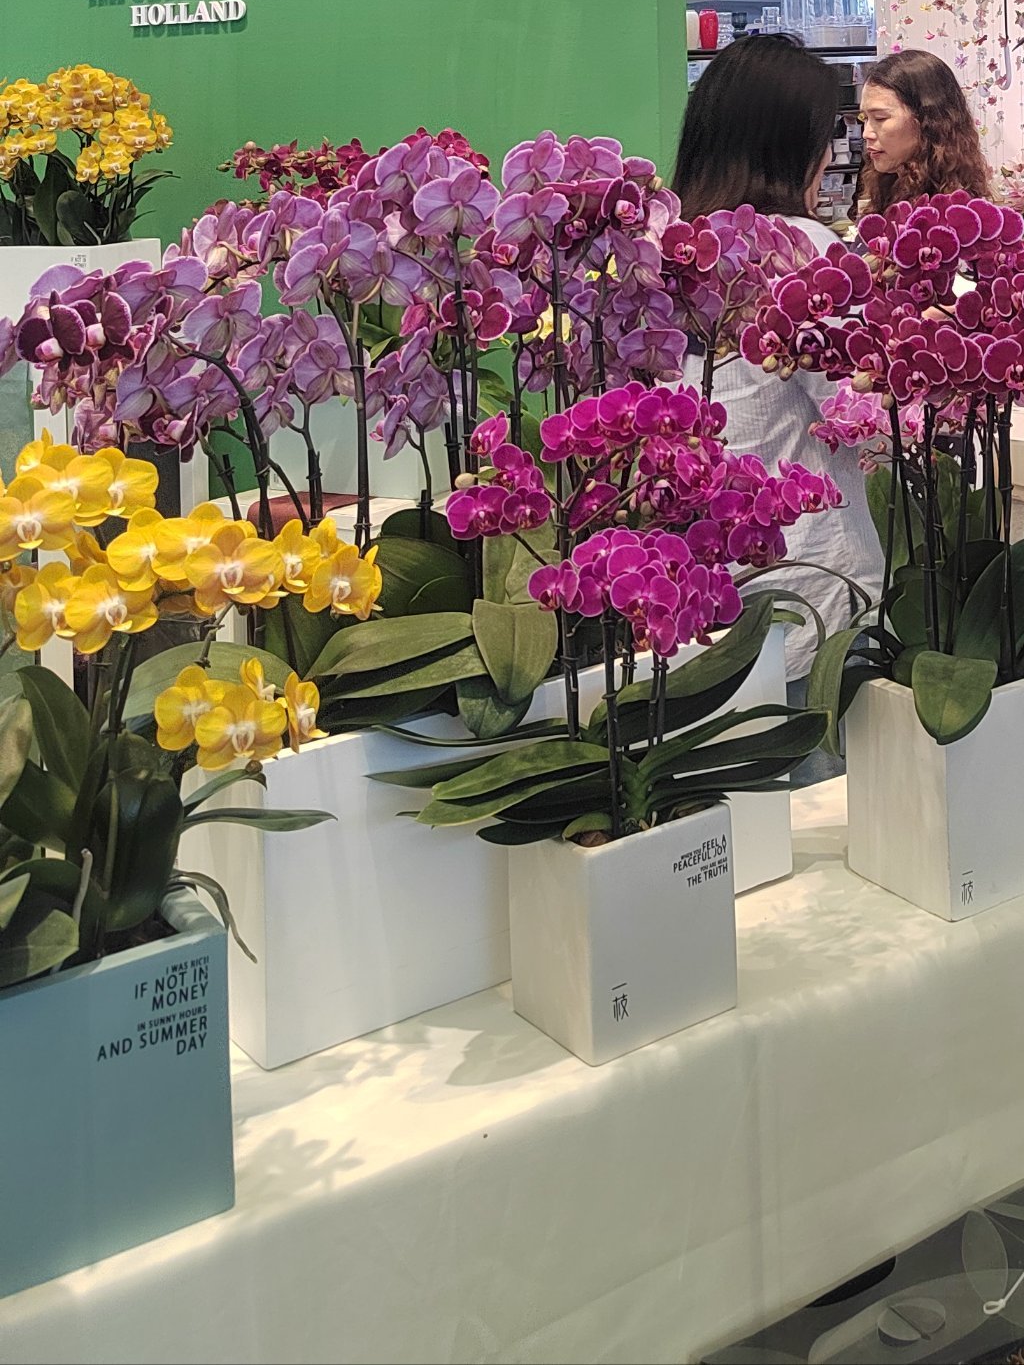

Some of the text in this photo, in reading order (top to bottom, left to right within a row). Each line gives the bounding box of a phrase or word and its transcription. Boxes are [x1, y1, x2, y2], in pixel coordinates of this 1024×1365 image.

[673, 842, 727, 873] PEACEFUL JOY
[702, 837, 719, 852] FEEL
[687, 862, 728, 888] THE TRUTH
[171, 961, 188, 973] WAS
[135, 965, 208, 1000] IF NOT IN
[152, 981, 208, 1012] MONEY
[137, 1004, 207, 1032] IN SUNNY HOURS
[97, 1015, 207, 1062] AND SUMMER
[176, 1032, 207, 1056] DAY
